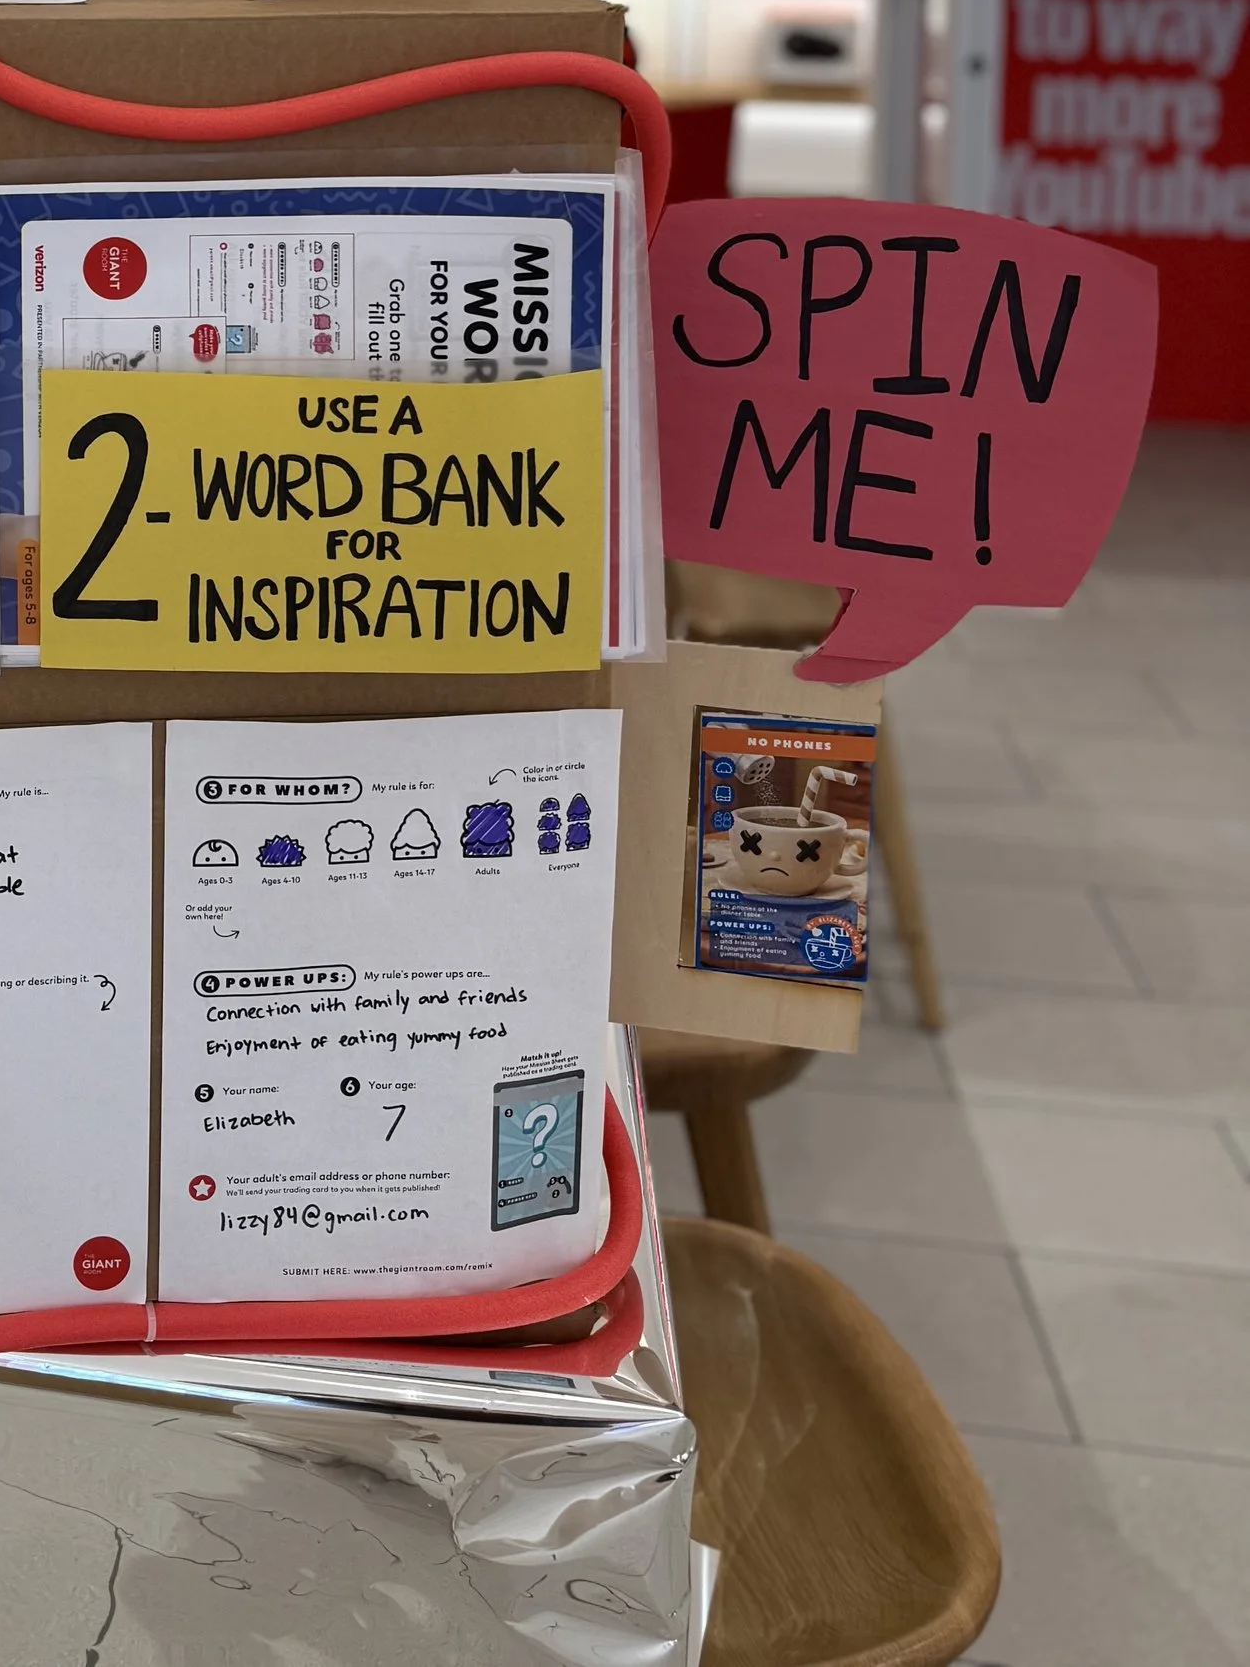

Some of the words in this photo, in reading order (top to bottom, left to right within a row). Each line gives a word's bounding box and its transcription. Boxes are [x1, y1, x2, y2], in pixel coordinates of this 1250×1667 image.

[1032, 73, 1220, 149] more
[35, 245, 46, 292] verizon
[109, 246, 120, 290] GIANT
[430, 260, 448, 305] FOR
[369, 302, 384, 324] fill
[389, 279, 405, 323] Grab
[672, 232, 1081, 403] SPIN
[368, 331, 382, 361] out
[389, 330, 401, 362] one
[430, 312, 448, 375] YOUR
[298, 394, 376, 434] USE
[389, 395, 423, 435] A
[192, 448, 362, 522] WORD
[381, 448, 565, 528] BANK
[710, 399, 992, 565] ME!
[24, 546, 35, 566] For
[326, 530, 401, 560] FOR
[22, 570, 33, 599] ages
[25, 604, 36, 624] 5-8
[188, 572, 570, 642] INSPIRATION
[748, 737, 767, 748] NO
[774, 739, 832, 751] PHONES
[229, 783, 267, 796] FOR
[275, 783, 350, 796] WHOM?
[372, 783, 384, 793] My
[387, 782, 406, 791] rule
[408, 782, 417, 791] is
[418, 781, 435, 791] for:
[15, 979, 25, 987] or
[27, 975, 77, 987] describing
[80, 974, 89, 983] it.
[225, 975, 295, 988] POWER
[303, 973, 347, 984] UPS:
[206, 1002, 300, 1022] Connection
[311, 998, 346, 1014] with
[355, 989, 410, 1014] family
[418, 991, 449, 1006] and
[458, 987, 528, 1006] friends
[207, 1038, 302, 1057] Enjoyment
[311, 1035, 328, 1049] of
[338, 1029, 398, 1052] eating
[408, 1029, 461, 1049] yummy
[468, 1022, 507, 1039] food
[222, 1087, 247, 1096] Your
[249, 1085, 279, 1094] name:
[368, 1081, 392, 1090] Your
[395, 1082, 416, 1091] age:
[203, 1110, 296, 1133] Elizabeth
[382, 1104, 406, 1142] 7
[226, 1176, 250, 1185] Your
[252, 1173, 287, 1183] adult's
[289, 1172, 317, 1182] email
[319, 1172, 360, 1182] address
[362, 1173, 373, 1181] or
[375, 1171, 407, 1183] phone
[409, 1170, 450, 1180] number:
[220, 1204, 429, 1236] lizzy84@gmail.com
[82, 1259, 121, 1269] GIANT
